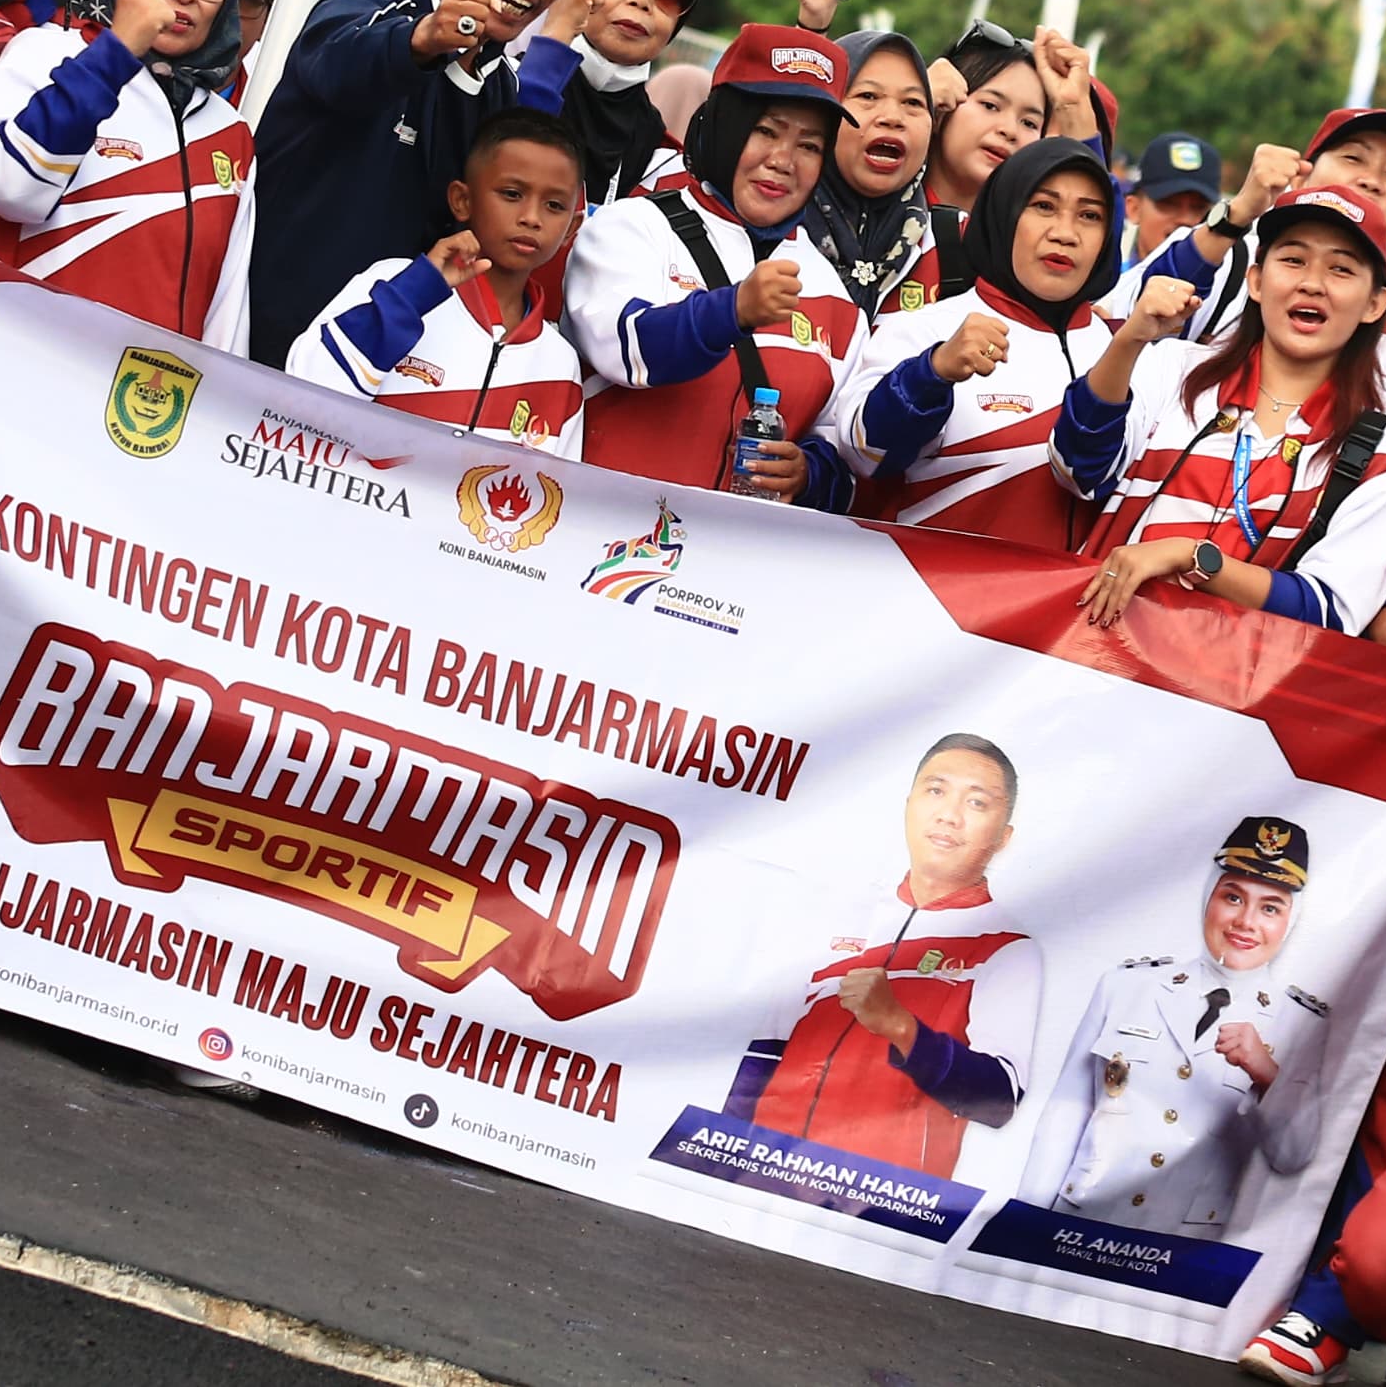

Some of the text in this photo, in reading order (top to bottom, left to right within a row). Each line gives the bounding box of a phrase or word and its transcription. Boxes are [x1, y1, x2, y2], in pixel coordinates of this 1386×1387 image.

[130, 351, 195, 379] BANJARMASIN
[250, 419, 351, 468] MAJU
[262, 408, 355, 449] BANJARMASIN
[221, 434, 412, 519] SEJAHTERA
[439, 541, 546, 581] KONI BANJARMASIN
[658, 584, 745, 618] PORPROV XII
[277, 601, 410, 694] KOTA
[423, 642, 810, 801] BANJARMASIN
[167, 809, 453, 914] SPORTIF
[234, 943, 367, 1059] MAJU
[370, 1001, 622, 1122] SEJAHTERA
[242, 1045, 387, 1105] konibanjarmasin
[451, 1113, 597, 1170] konibanjarmasin
[691, 1127, 941, 1209] ARIF RAHMAN HAKIM
[677, 1141, 946, 1226] SEKRETARIS UMUM KONI BANJARMASIN
[1053, 1229, 1172, 1264] HJ. ANANDA
[1056, 1244, 1158, 1275] WAKIL WALI KOTA
